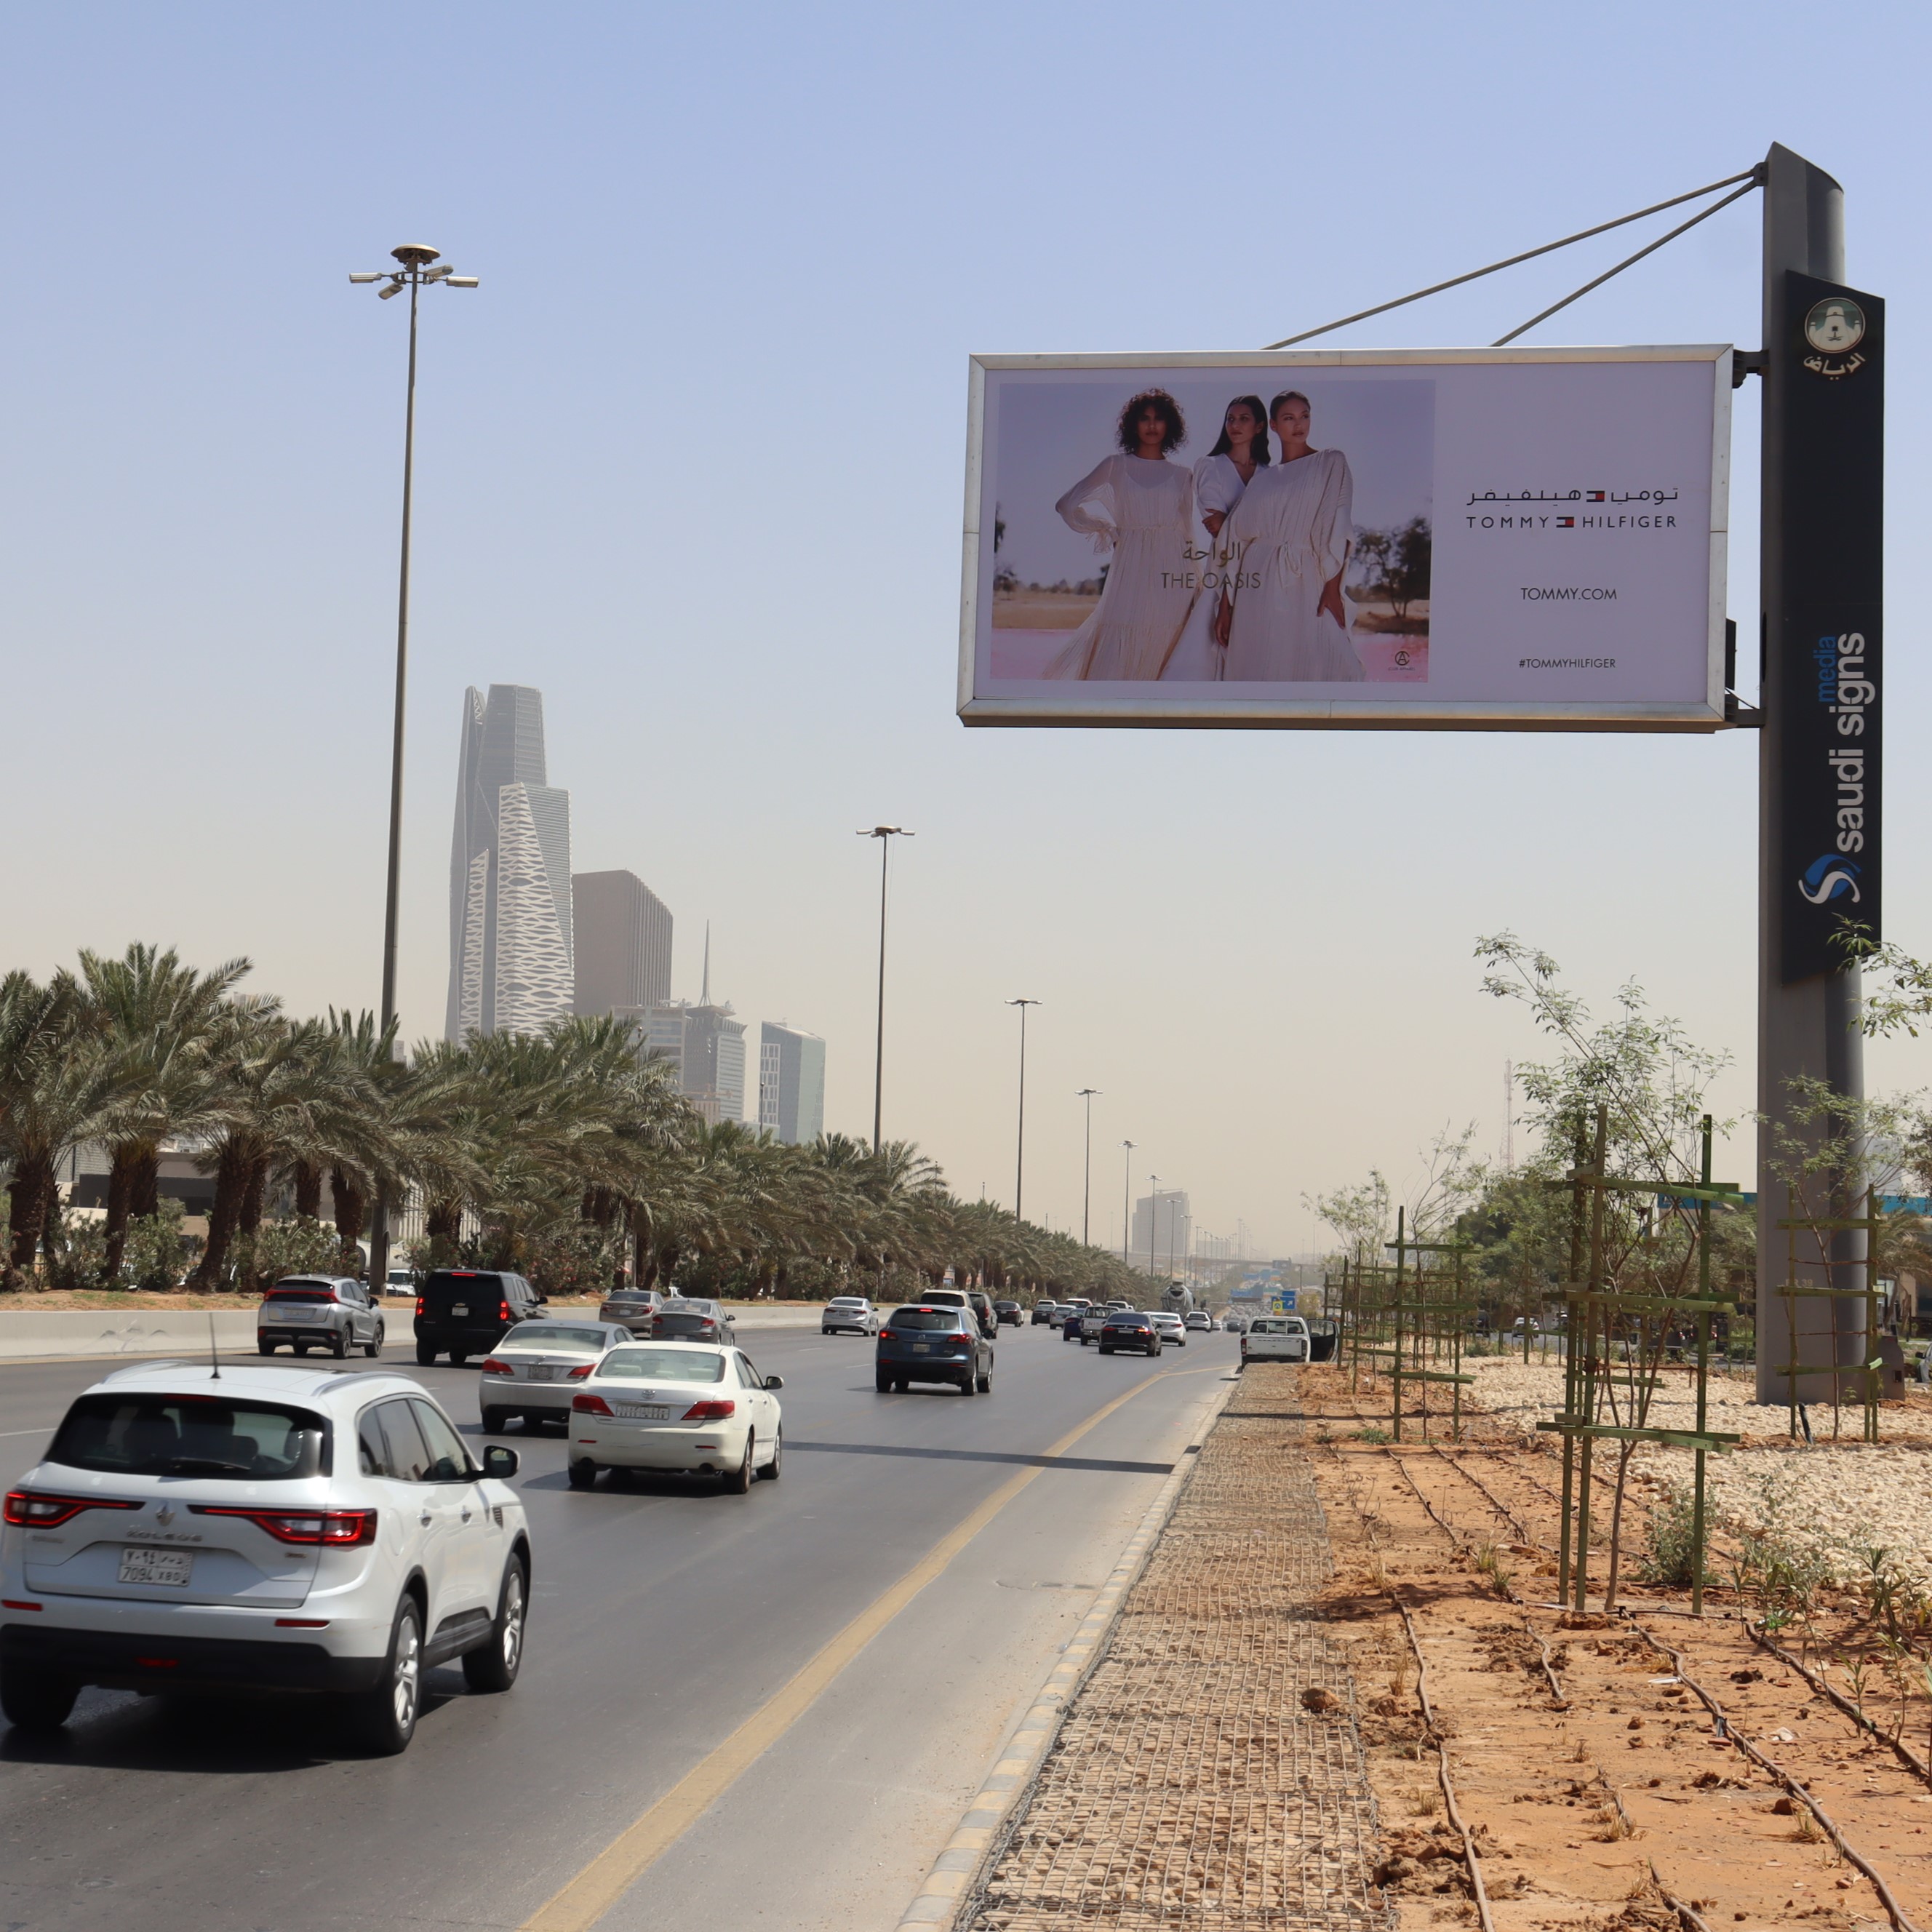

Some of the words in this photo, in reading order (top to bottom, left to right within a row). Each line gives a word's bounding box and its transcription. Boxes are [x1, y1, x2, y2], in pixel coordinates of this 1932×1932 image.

[1803, 353, 1866, 380] الرياض
[1466, 516, 1549, 529] TOMMY
[1582, 515, 1677, 529] HILFIGER
[1182, 540, 1241, 568] الواحة
[1161, 572, 1195, 589] THE
[1202, 572, 1261, 589] OASIS
[1520, 587, 1618, 601] TOMMY.COM
[1518, 658, 1616, 669] #TOMMYHILFIGER
[1813, 635, 1837, 703] media
[1828, 632, 1876, 736] signs
[1828, 749, 1864, 853] saudi
[121, 1566, 154, 1582] 7094
